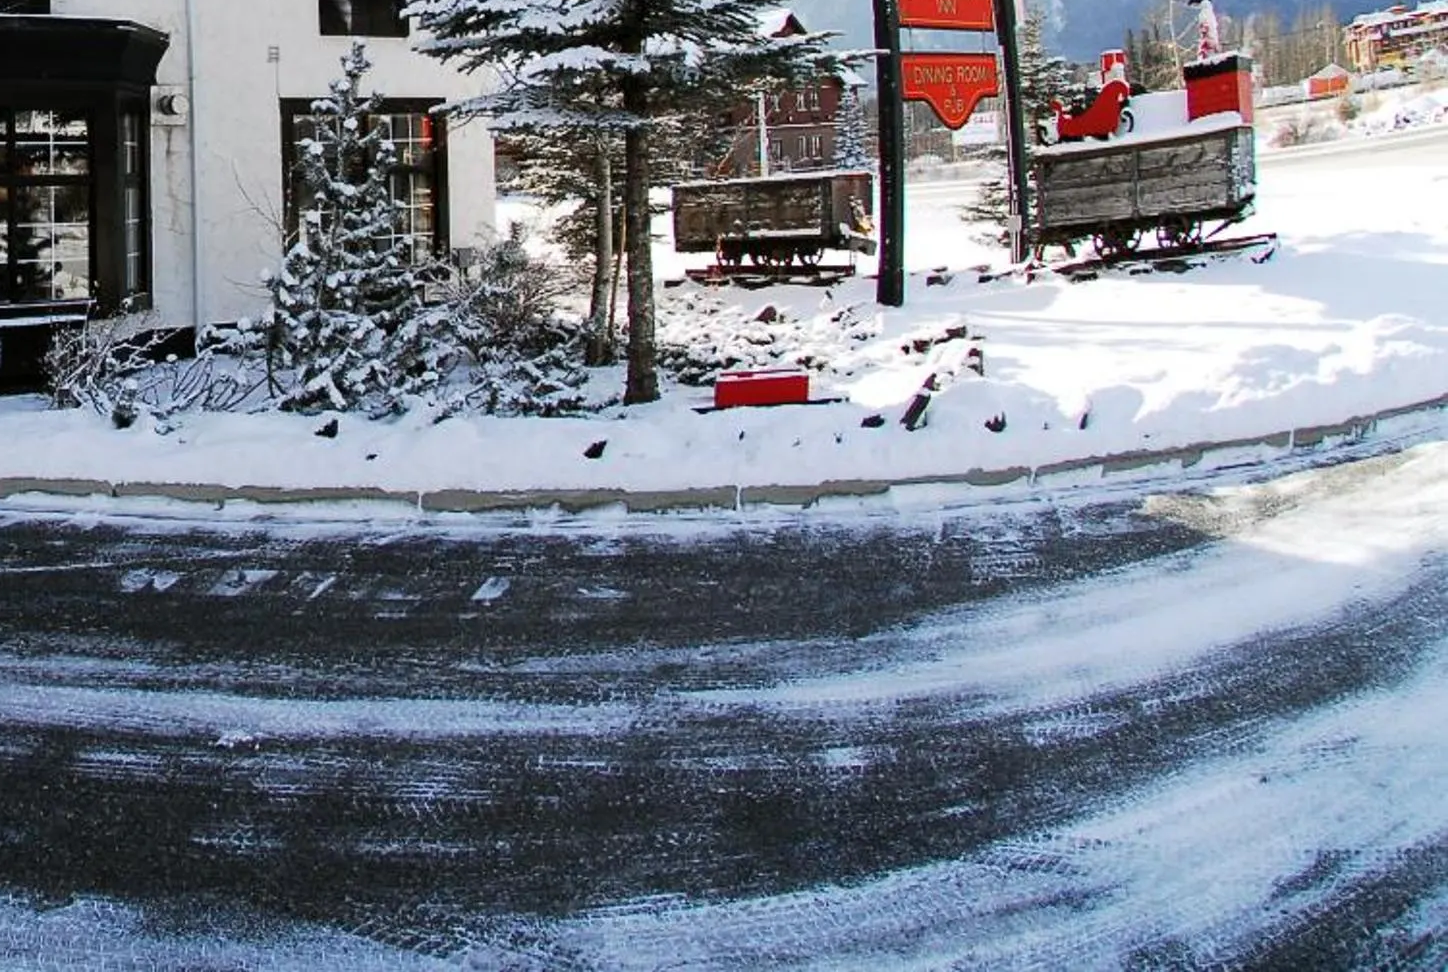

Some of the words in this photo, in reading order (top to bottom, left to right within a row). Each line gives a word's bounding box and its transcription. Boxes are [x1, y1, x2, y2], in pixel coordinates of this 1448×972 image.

[913, 66, 953, 85] DINING
[956, 66, 988, 84] ROOM
[944, 98, 965, 114] PUB
